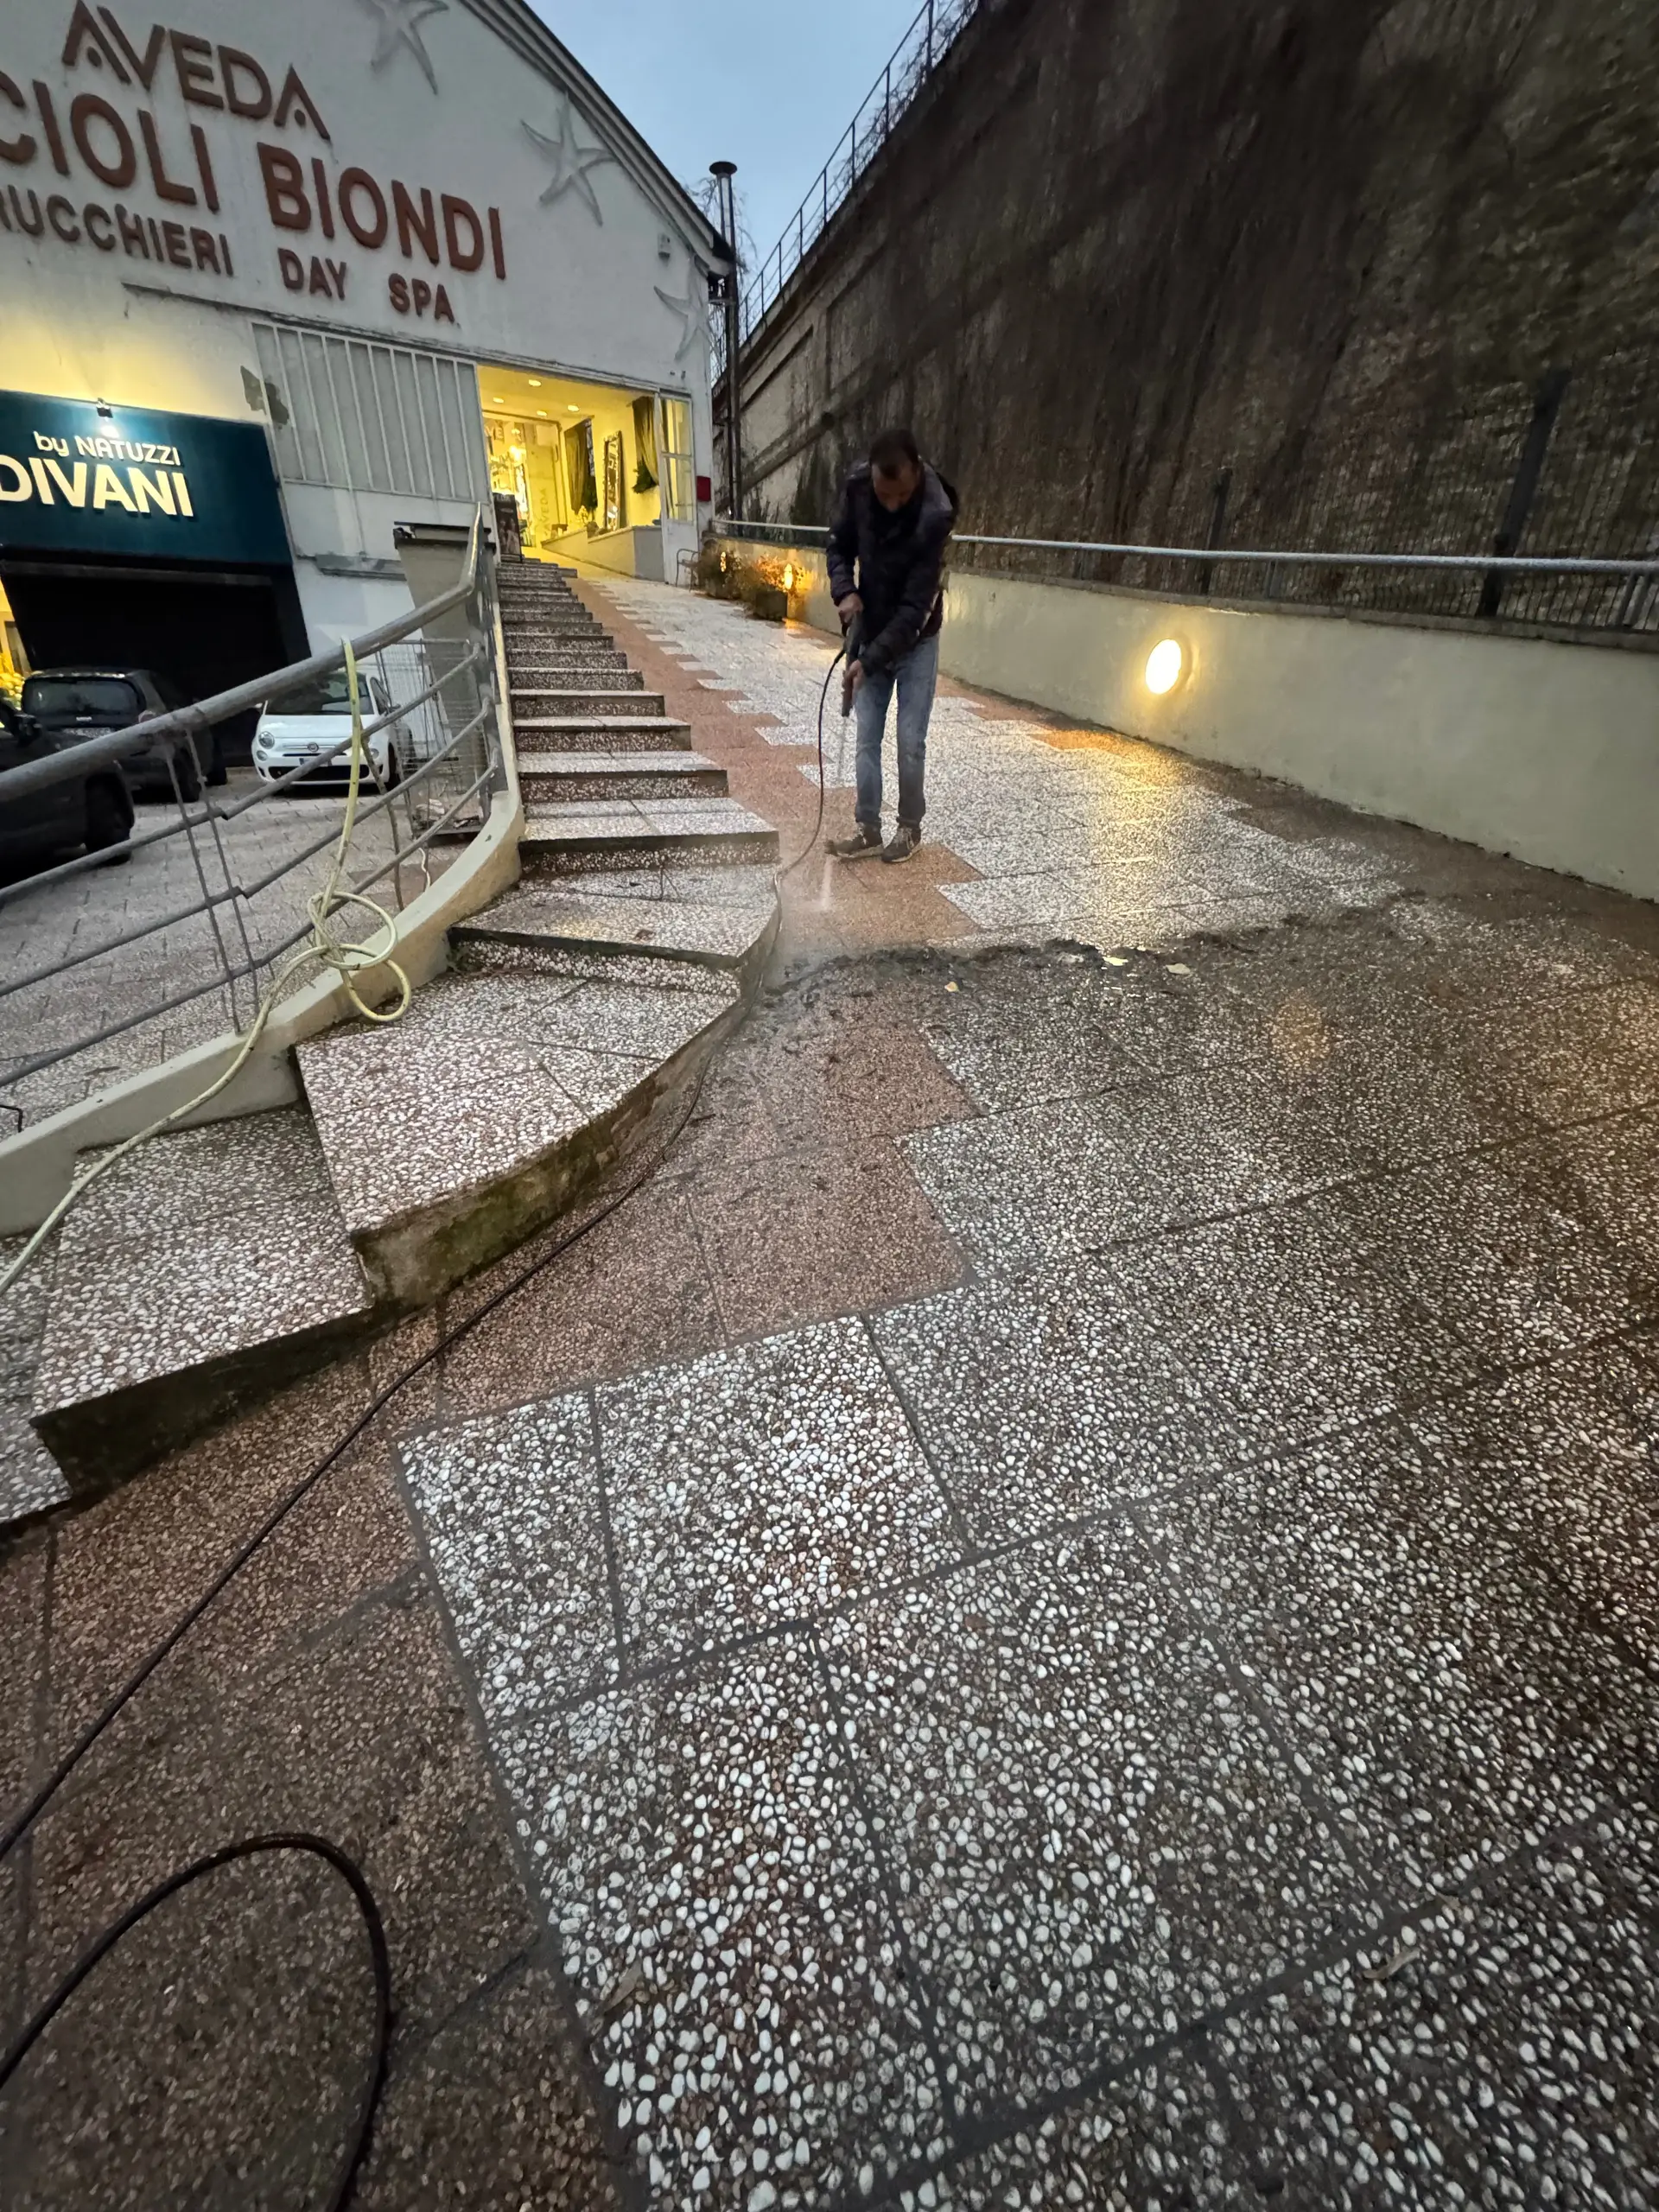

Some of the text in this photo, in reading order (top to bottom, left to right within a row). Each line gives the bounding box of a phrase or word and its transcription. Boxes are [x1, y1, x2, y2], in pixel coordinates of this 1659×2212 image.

[61, 0, 331, 141] AVEDA
[0, 183, 455, 325] UCCHIERI DAY SPA
[257, 141, 506, 281] BIONDI
[0, 454, 194, 517] DIVANI
[33, 430, 181, 466] by NATUZZI
